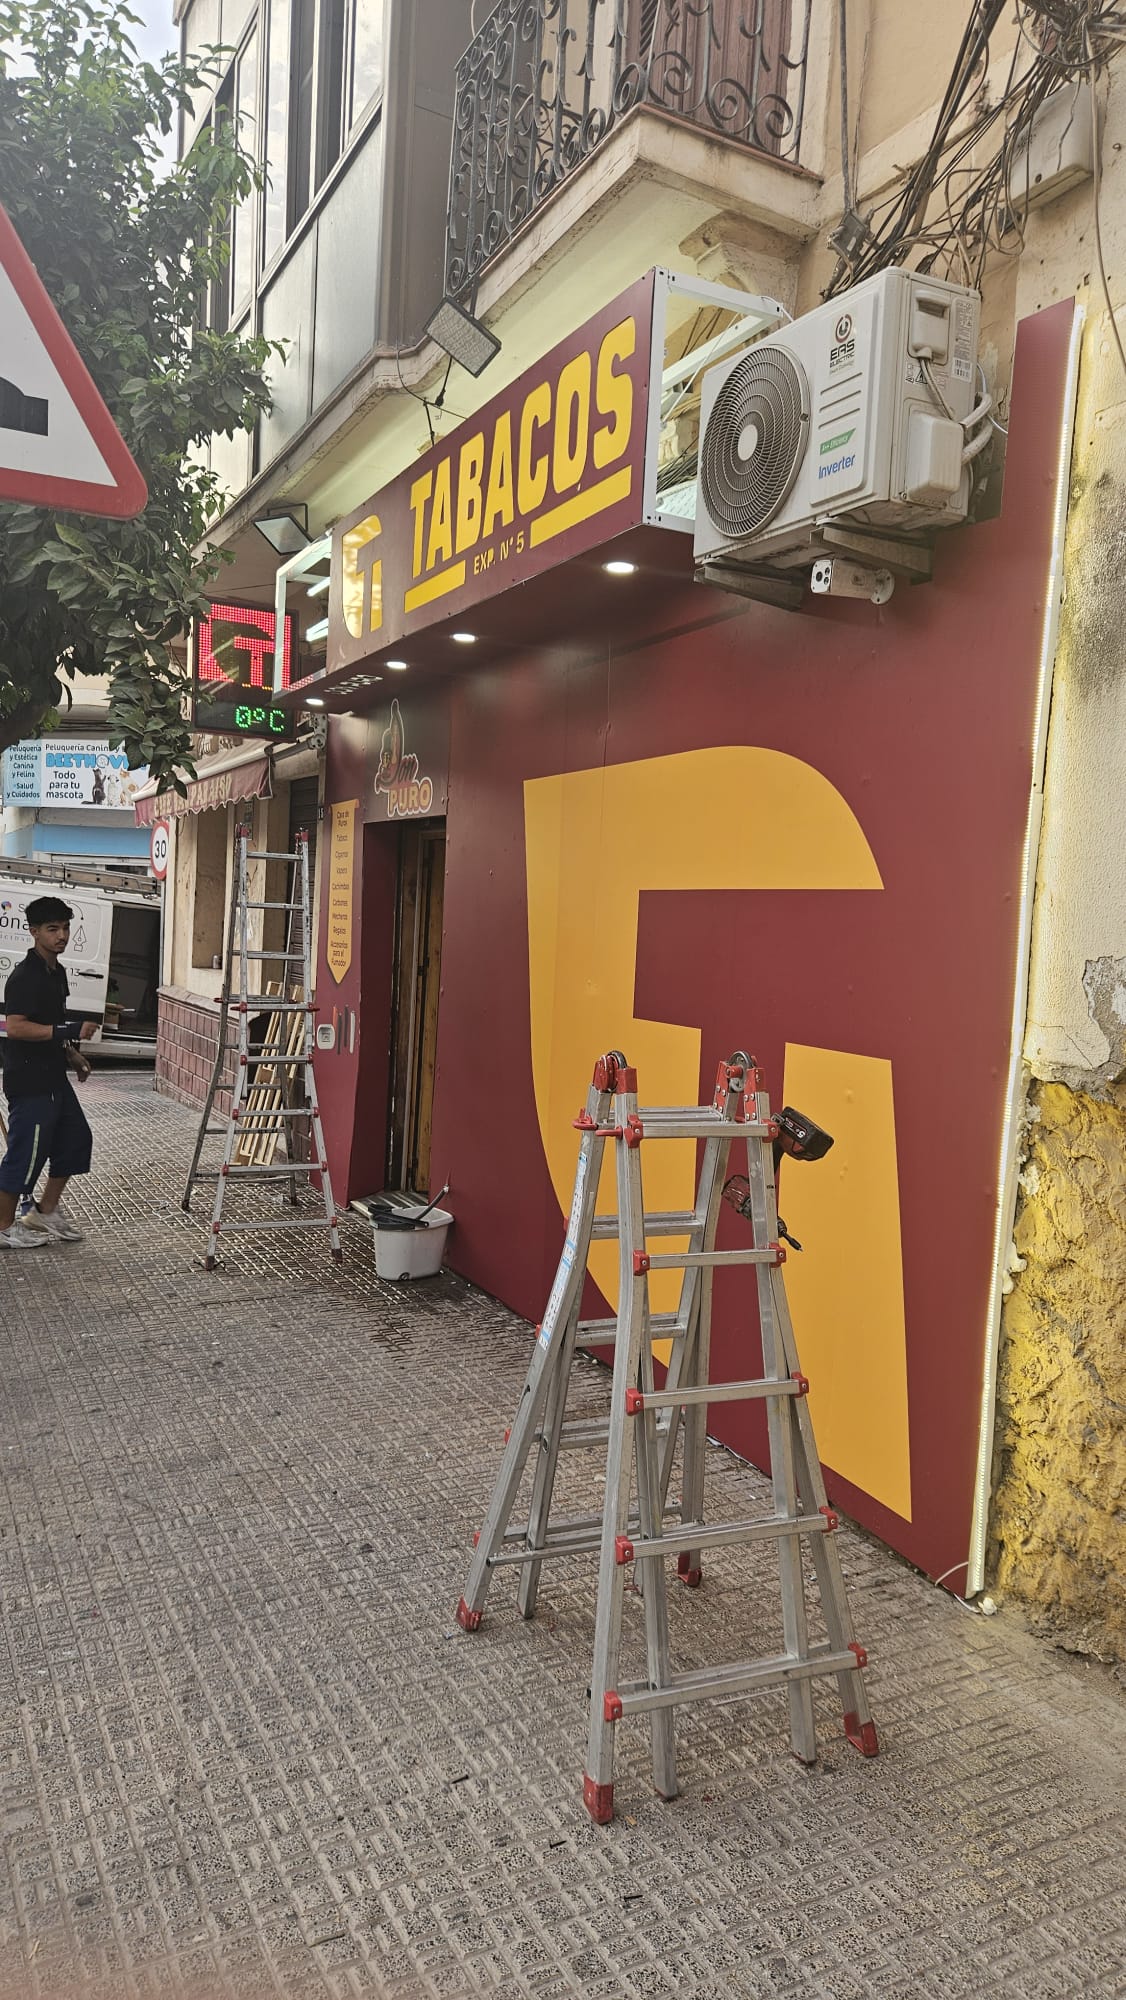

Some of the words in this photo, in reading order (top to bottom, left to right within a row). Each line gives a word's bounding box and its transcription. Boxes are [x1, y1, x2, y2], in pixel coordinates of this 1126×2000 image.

[830, 338, 855, 362] EAS
[410, 315, 636, 580] TABACOS
[818, 454, 857, 480] Inverter
[473, 547, 496, 576] EXP.
[516, 530, 525, 554] 5
[45, 743, 85, 752] Peluquería
[86, 744, 109, 752] Canin
[53, 771, 76, 780] Todo
[16, 782, 34, 790] Salud
[49, 781, 68, 790] para
[70, 781, 80, 790] tu
[11, 791, 40, 799] Cuidados
[46, 790, 84, 799] mascota
[389, 782, 431, 813] PURO
[154, 839, 167, 858] 30
